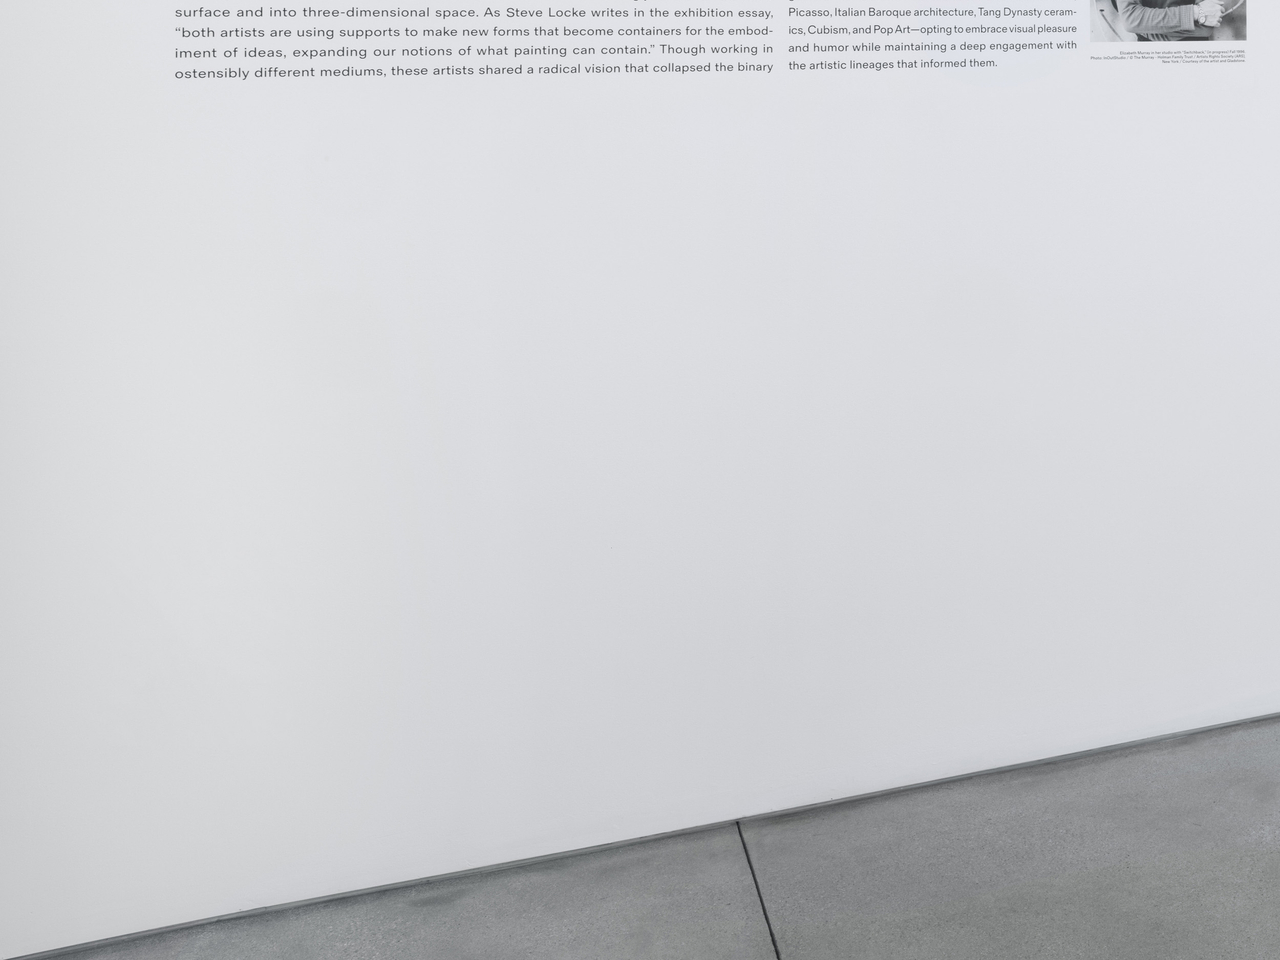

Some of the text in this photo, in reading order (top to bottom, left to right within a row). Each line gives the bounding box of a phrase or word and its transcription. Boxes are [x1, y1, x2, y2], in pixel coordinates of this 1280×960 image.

[174, 5, 773, 20] surface and into three-dimensional space. As Steve Locke writes in the exhibition essay,
[787, 6, 1077, 19] Picasso, Italian Baroque architecture, Tang Dynasty ceram-
[787, 57, 998, 71] the artistic lineages that informed them.
